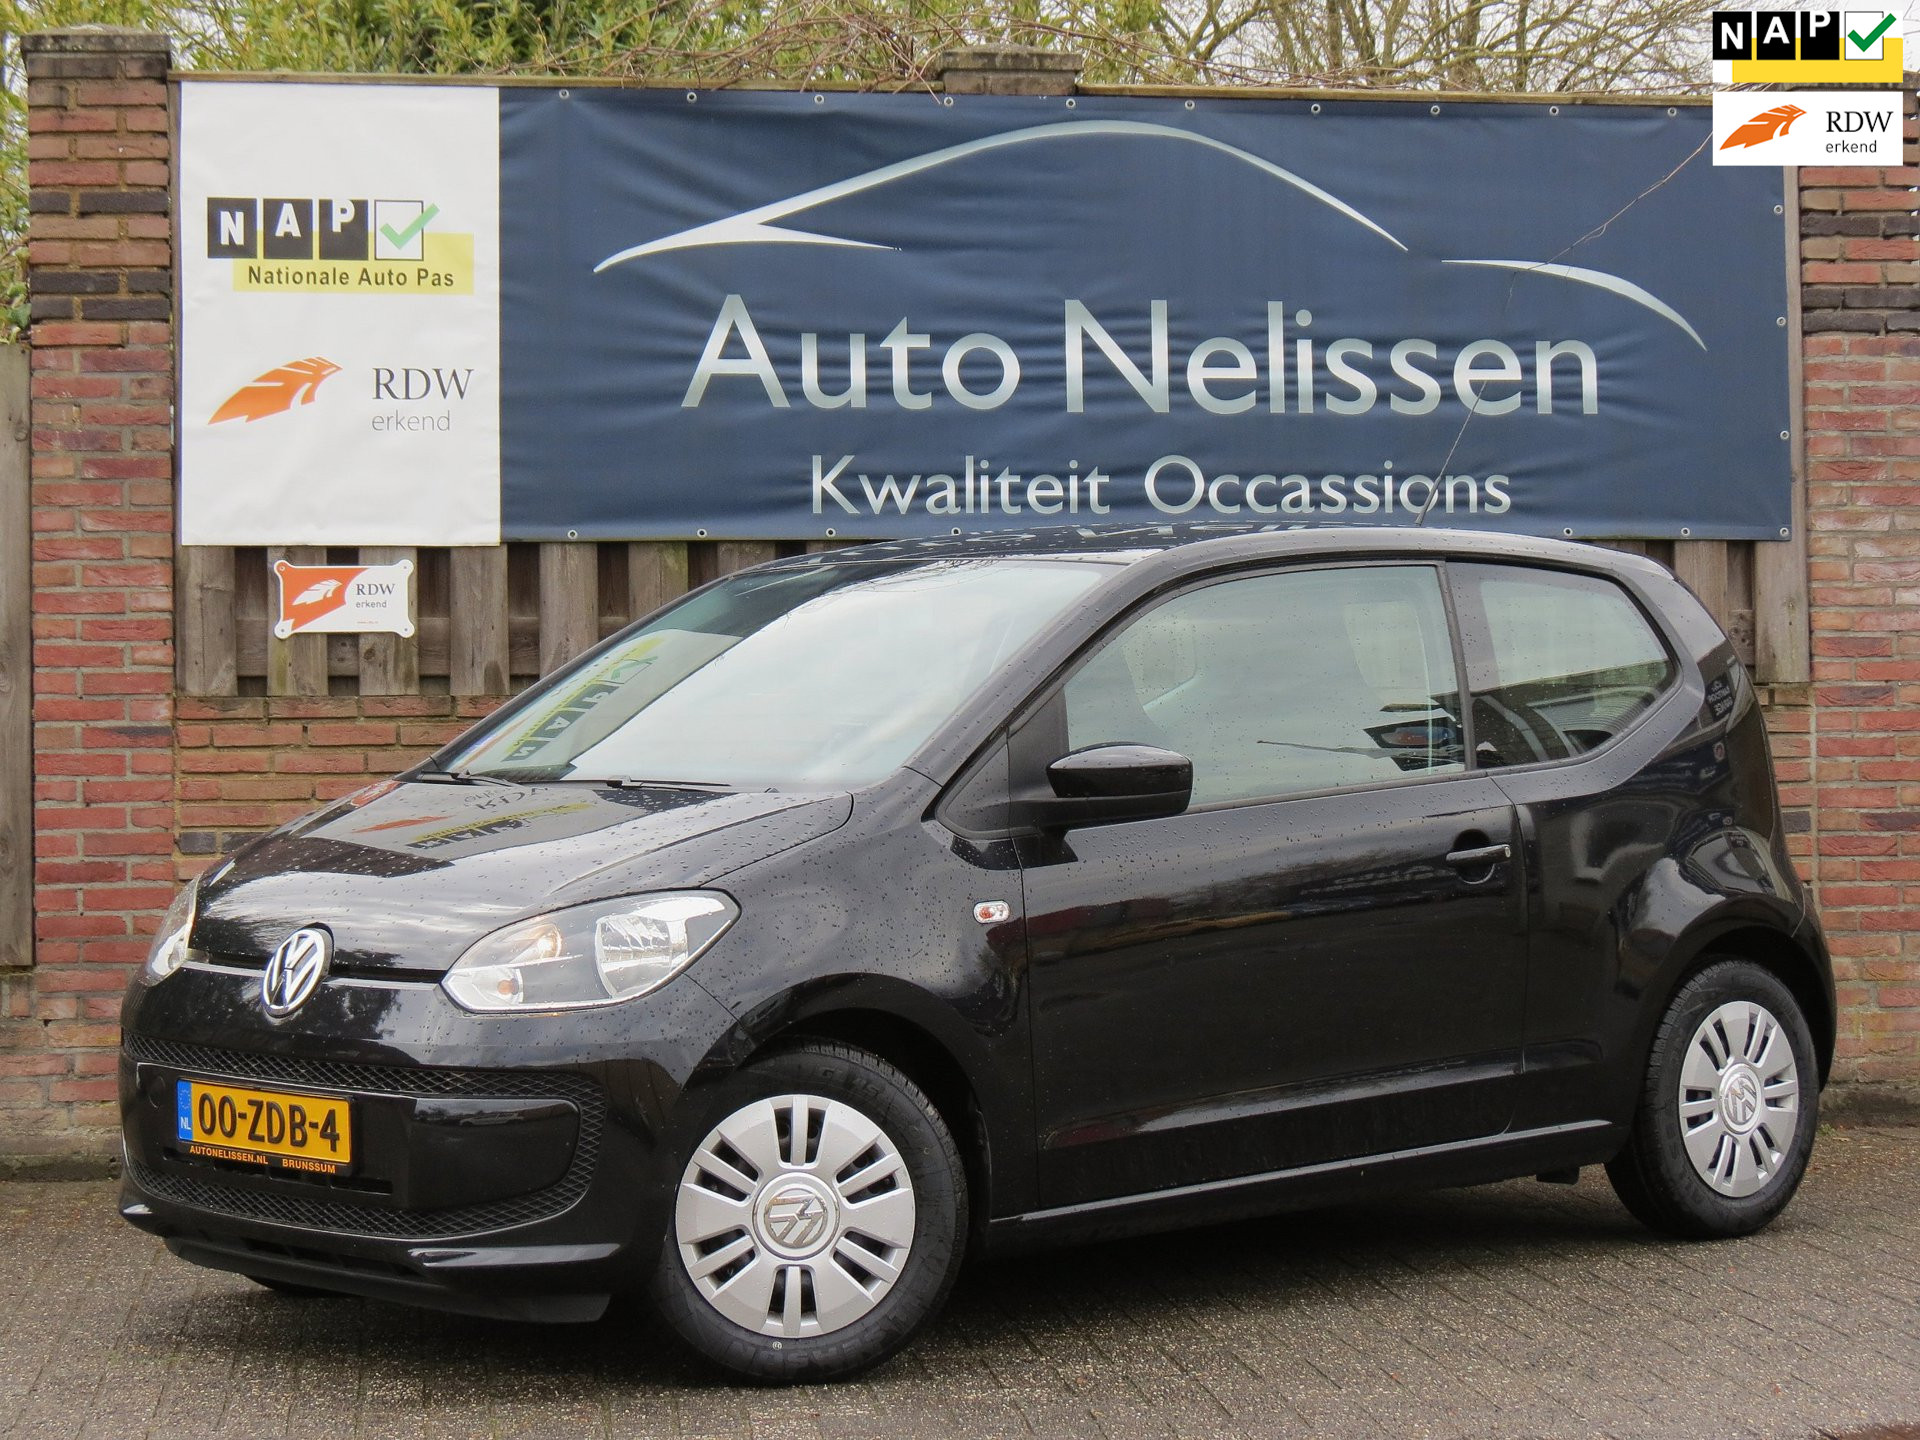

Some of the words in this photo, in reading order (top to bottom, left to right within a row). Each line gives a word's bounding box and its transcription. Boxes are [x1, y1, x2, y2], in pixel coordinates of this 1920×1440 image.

[219, 199, 355, 246] NAP
[248, 265, 350, 286] Nationale
[358, 267, 408, 287] Auto
[416, 268, 454, 287] Pas
[681, 294, 1021, 410] Auto
[1065, 299, 1598, 415] Nelissen
[372, 367, 474, 401] RDW
[371, 409, 451, 431] erkend
[812, 454, 1111, 515] Kwaliteit
[1144, 454, 1512, 514] Occassions
[355, 599, 387, 608] erkend
[356, 583, 396, 596] RDW
[180, 1116, 192, 1131] NL
[198, 1092, 341, 1153] 00-ZDB-4
[189, 1144, 269, 1165] AUTONELISSEN.NL
[282, 1157, 336, 1174] BRUNSSUM
